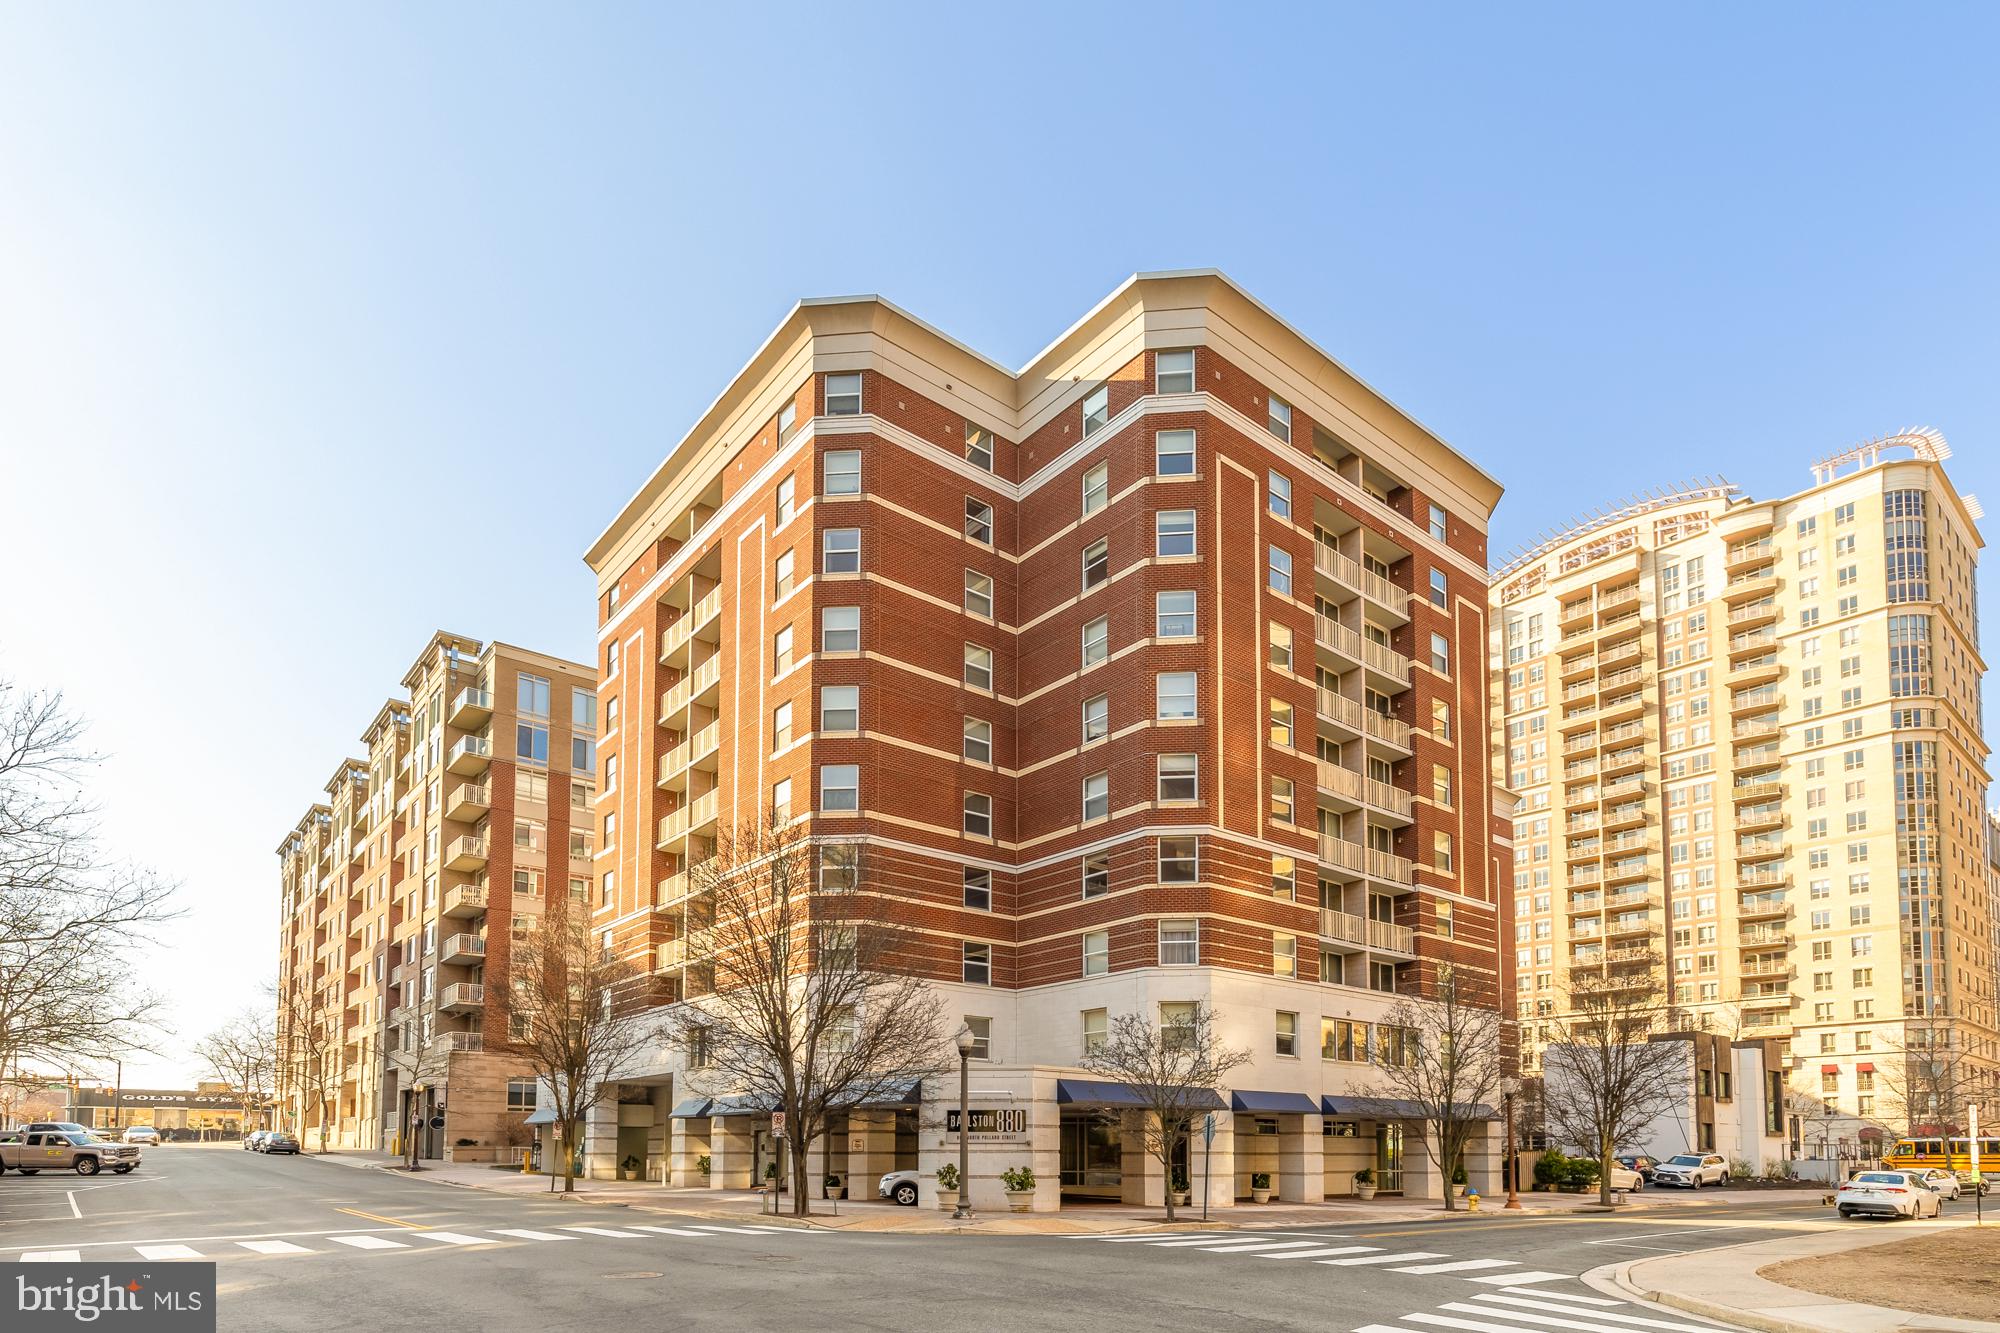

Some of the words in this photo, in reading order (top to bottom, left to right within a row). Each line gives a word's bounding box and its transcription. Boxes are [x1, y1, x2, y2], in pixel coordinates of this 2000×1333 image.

[122, 1094, 186, 1102] GOLD'S
[950, 1115, 994, 1127] BALSTON
[996, 1110, 1023, 1132] 880
